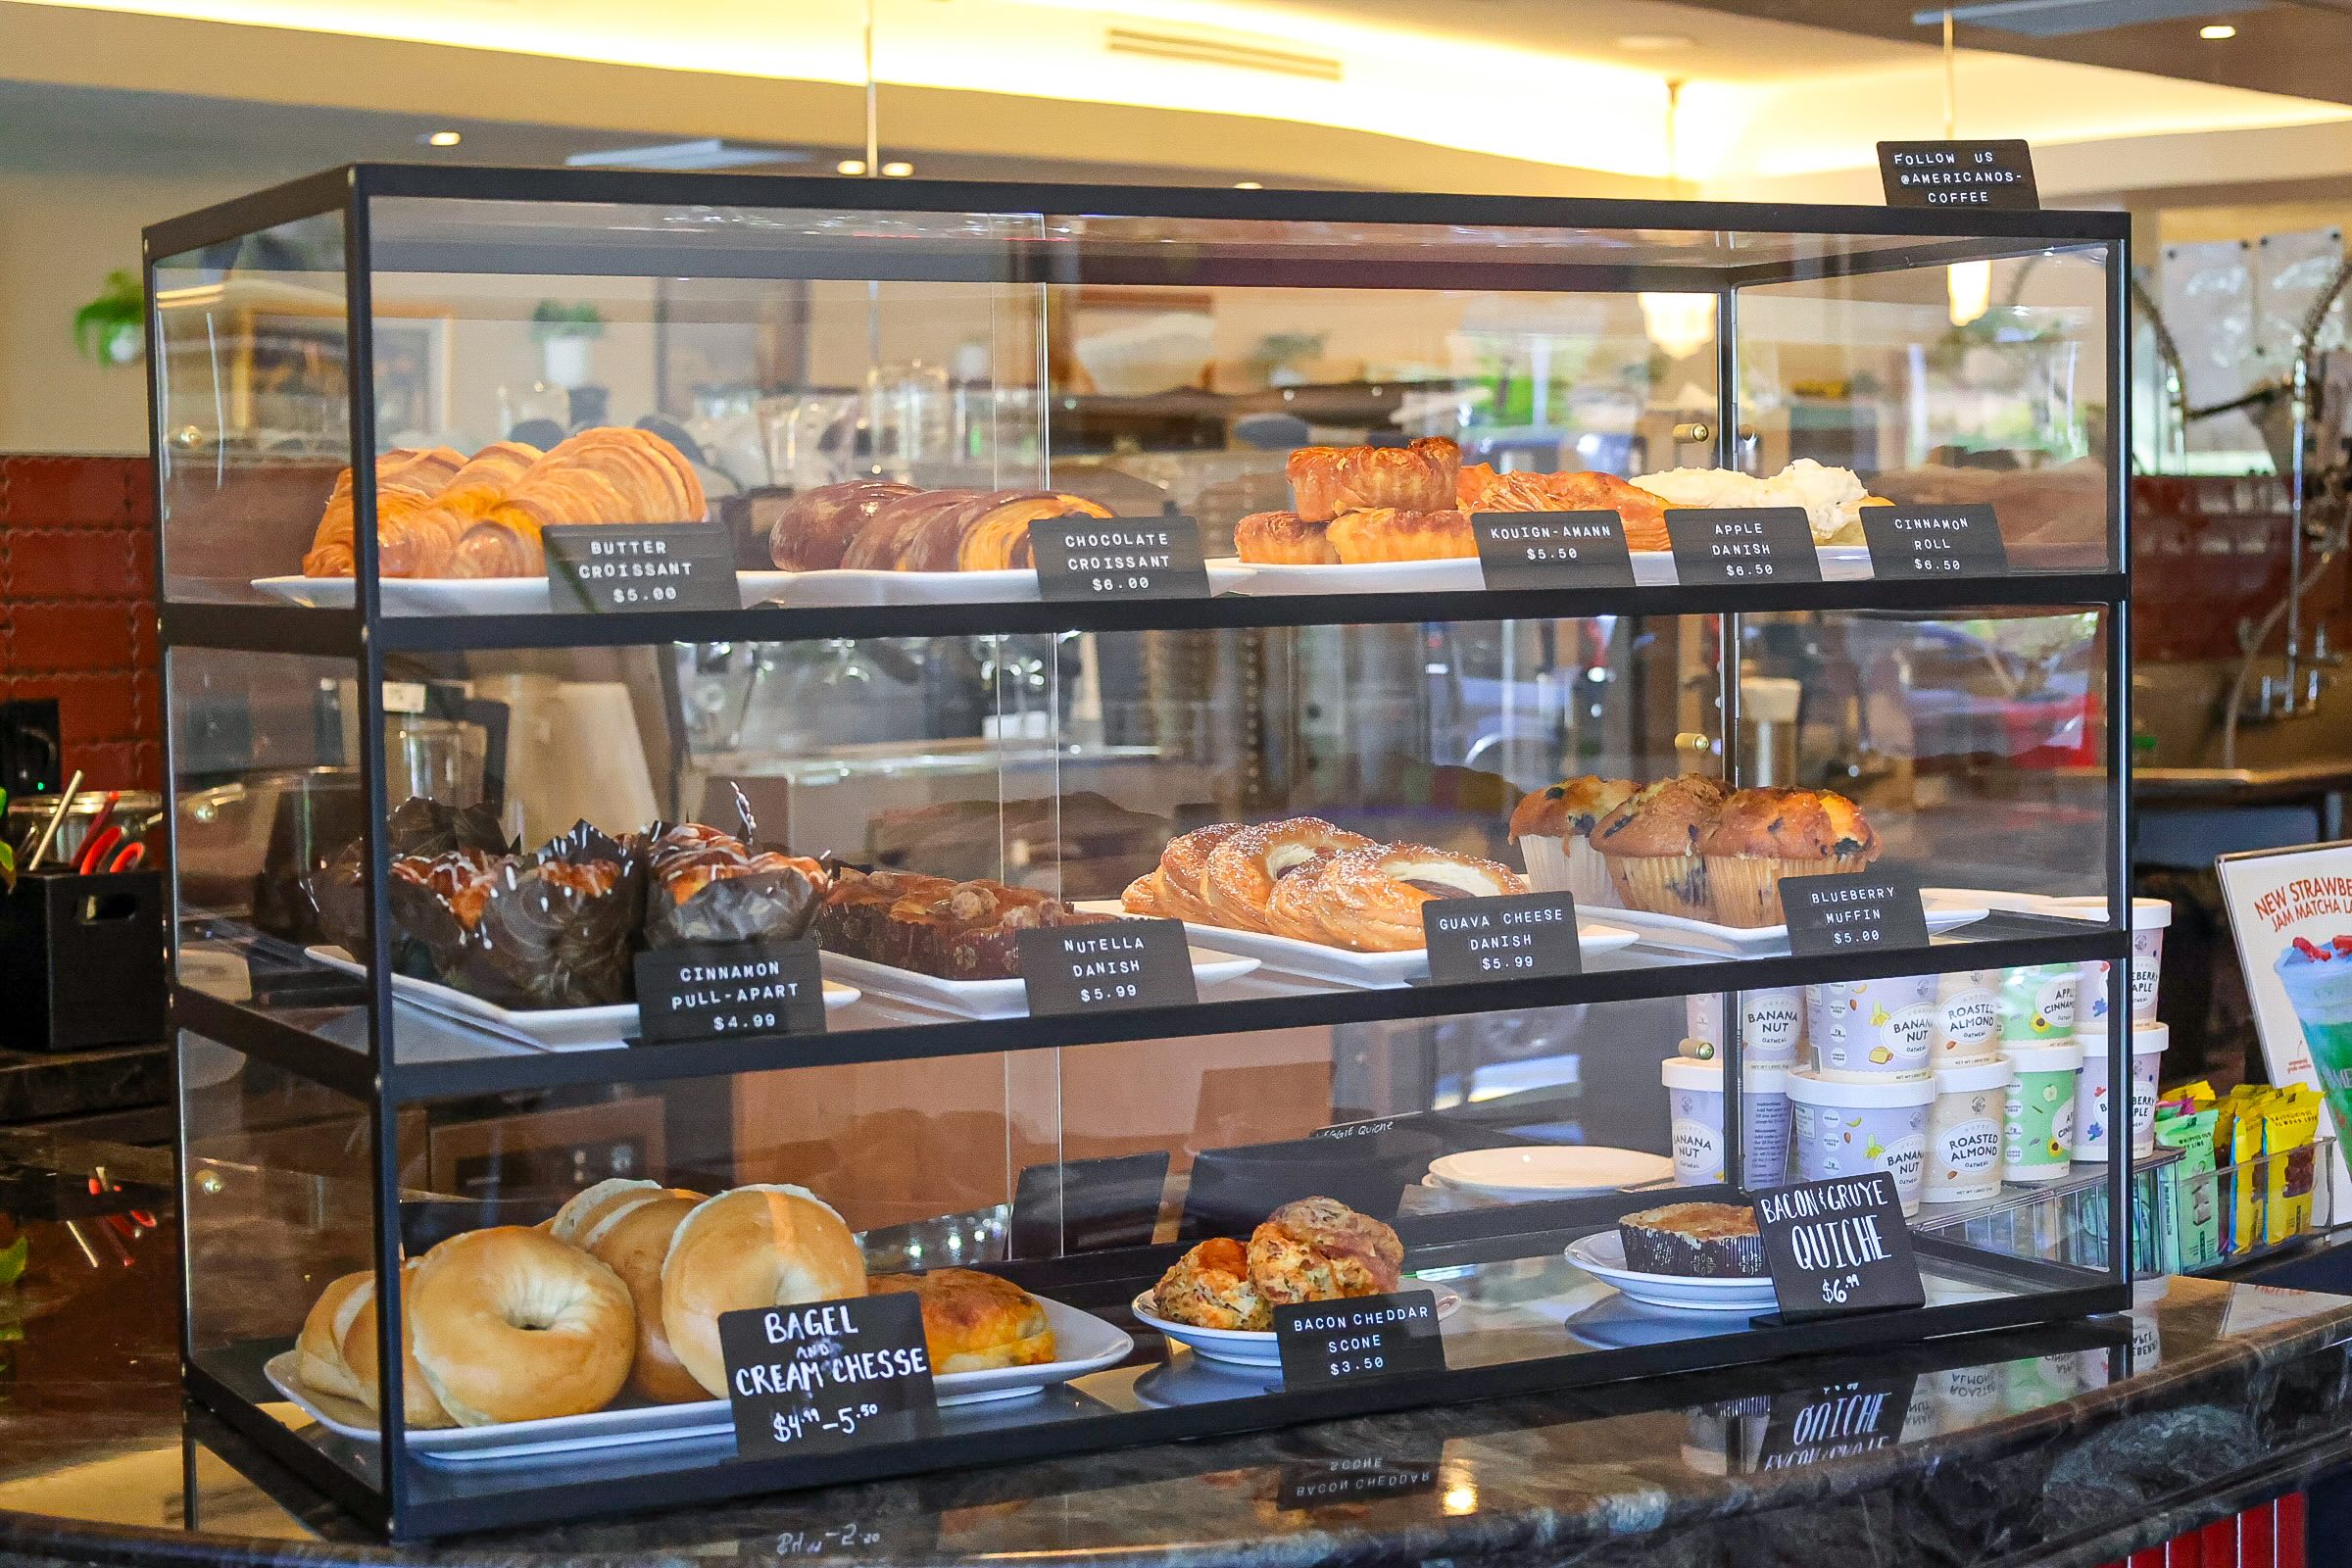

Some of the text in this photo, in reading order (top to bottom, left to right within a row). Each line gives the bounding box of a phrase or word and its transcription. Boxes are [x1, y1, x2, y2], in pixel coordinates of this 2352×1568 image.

[1893, 151, 1994, 166] FOLLOW US
[1928, 191, 1988, 203] COFFEE
[1714, 522, 1763, 536] APPLE
[1894, 516, 1969, 531] CINNAMON
[1064, 533, 1168, 548] CHOCOLATE
[1490, 525, 1611, 540] KOUIGN-AMANN
[590, 540, 667, 555] BUTTER
[1712, 543, 1771, 557] DANISH
[1914, 538, 1951, 551] ROLL
[1527, 548, 1578, 561] $5.50
[578, 562, 693, 579] CROISSANT
[1067, 555, 1169, 571] CROISSANT
[1726, 564, 1774, 577] $6.50
[1914, 559, 1961, 571] $6.50
[1092, 576, 1150, 592] $6.00
[612, 586, 677, 604] $5.00
[1811, 886, 1895, 904] BLUEBERRY
[2254, 877, 2352, 920] NEW STRAWBE
[1439, 908, 1562, 931] GUAVA CHEESE
[1825, 908, 1881, 925] MUFFIN
[2272, 908, 2295, 933] JAM
[2295, 899, 2342, 921] MATCHA
[1470, 934, 1532, 951] DANISH
[1834, 929, 1880, 945] $5.00
[1064, 937, 1145, 954] NUTELLA
[679, 960, 780, 982] CINNAMON
[1072, 959, 1140, 978] DANISH
[1482, 956, 1534, 970] $5.99
[2132, 971, 2158, 982] EBERR
[671, 982, 799, 1010] PULL-APART
[1080, 984, 1137, 1003] $5.99
[2055, 988, 2075, 1001] APPL
[2132, 983, 2152, 993] APLE
[2044, 1001, 2075, 1014] CINNA
[712, 1012, 775, 1032] $4.99
[1747, 1010, 1798, 1023] BANANA
[1950, 1016, 1994, 1032] ALMOND
[1762, 1023, 1789, 1033] NUT
[1907, 1030, 1929, 1043] NUT
[2132, 1096, 2155, 1105] BERRY
[2132, 1107, 2148, 1117] PLE
[1316, 1126, 1353, 1140] EGGIE
[1949, 1133, 1998, 1150] ROASTED
[1679, 1147, 1699, 1158] NUT
[1886, 1151, 1924, 1166] BANAN
[1950, 1146, 1997, 1162] ALMOND
[1899, 1162, 1920, 1175] NUT
[1791, 1214, 1892, 1271] QUICHE
[1822, 1274, 1860, 1304] $6.99
[763, 1304, 859, 1345] BAGEL
[1294, 1306, 1428, 1333] BACON CHEDDAR
[796, 1343, 830, 1359] AND
[1328, 1334, 1382, 1353] SCONE
[735, 1348, 928, 1397] CREAM CHESSE
[1330, 1356, 1384, 1376] $3.50
